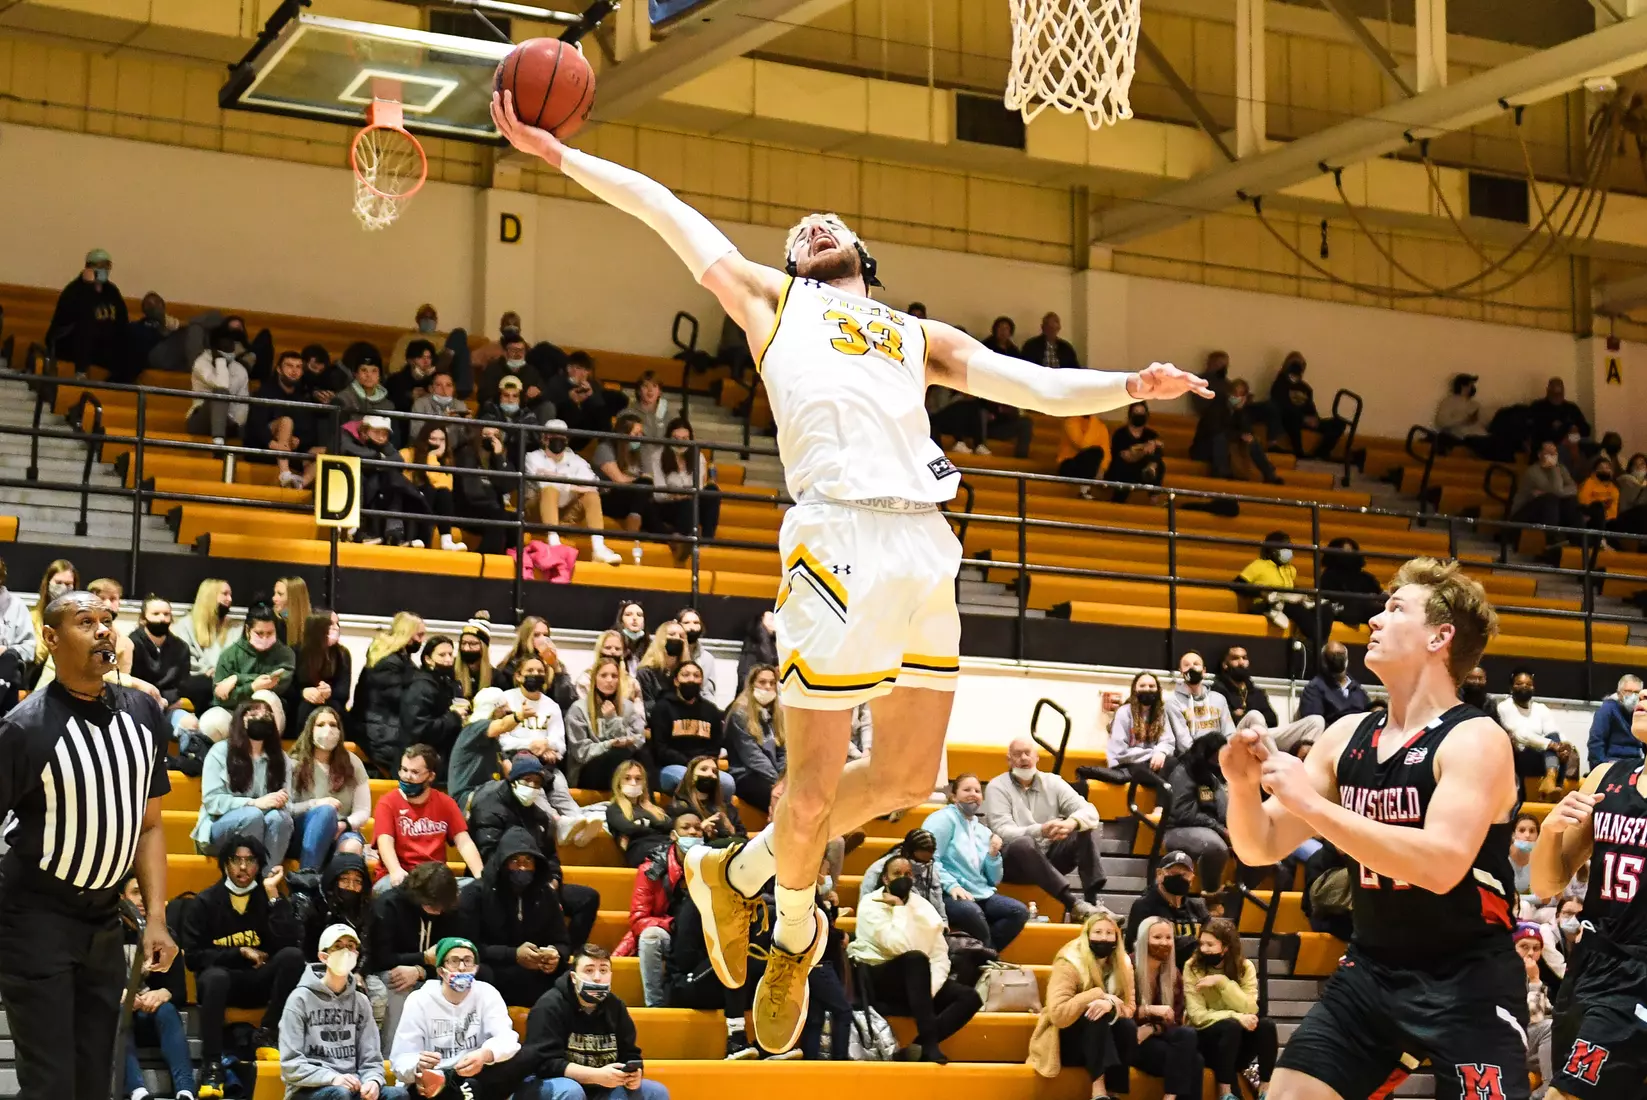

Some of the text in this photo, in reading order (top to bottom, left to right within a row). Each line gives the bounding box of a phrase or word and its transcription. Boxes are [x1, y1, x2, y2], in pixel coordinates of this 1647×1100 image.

[500, 212, 522, 243] D
[822, 309, 905, 366] 33
[1606, 358, 1622, 385] A
[320, 459, 355, 520] D
[1601, 851, 1645, 903] 15
[1455, 1063, 1507, 1100] M
[1563, 1038, 1610, 1086] M
